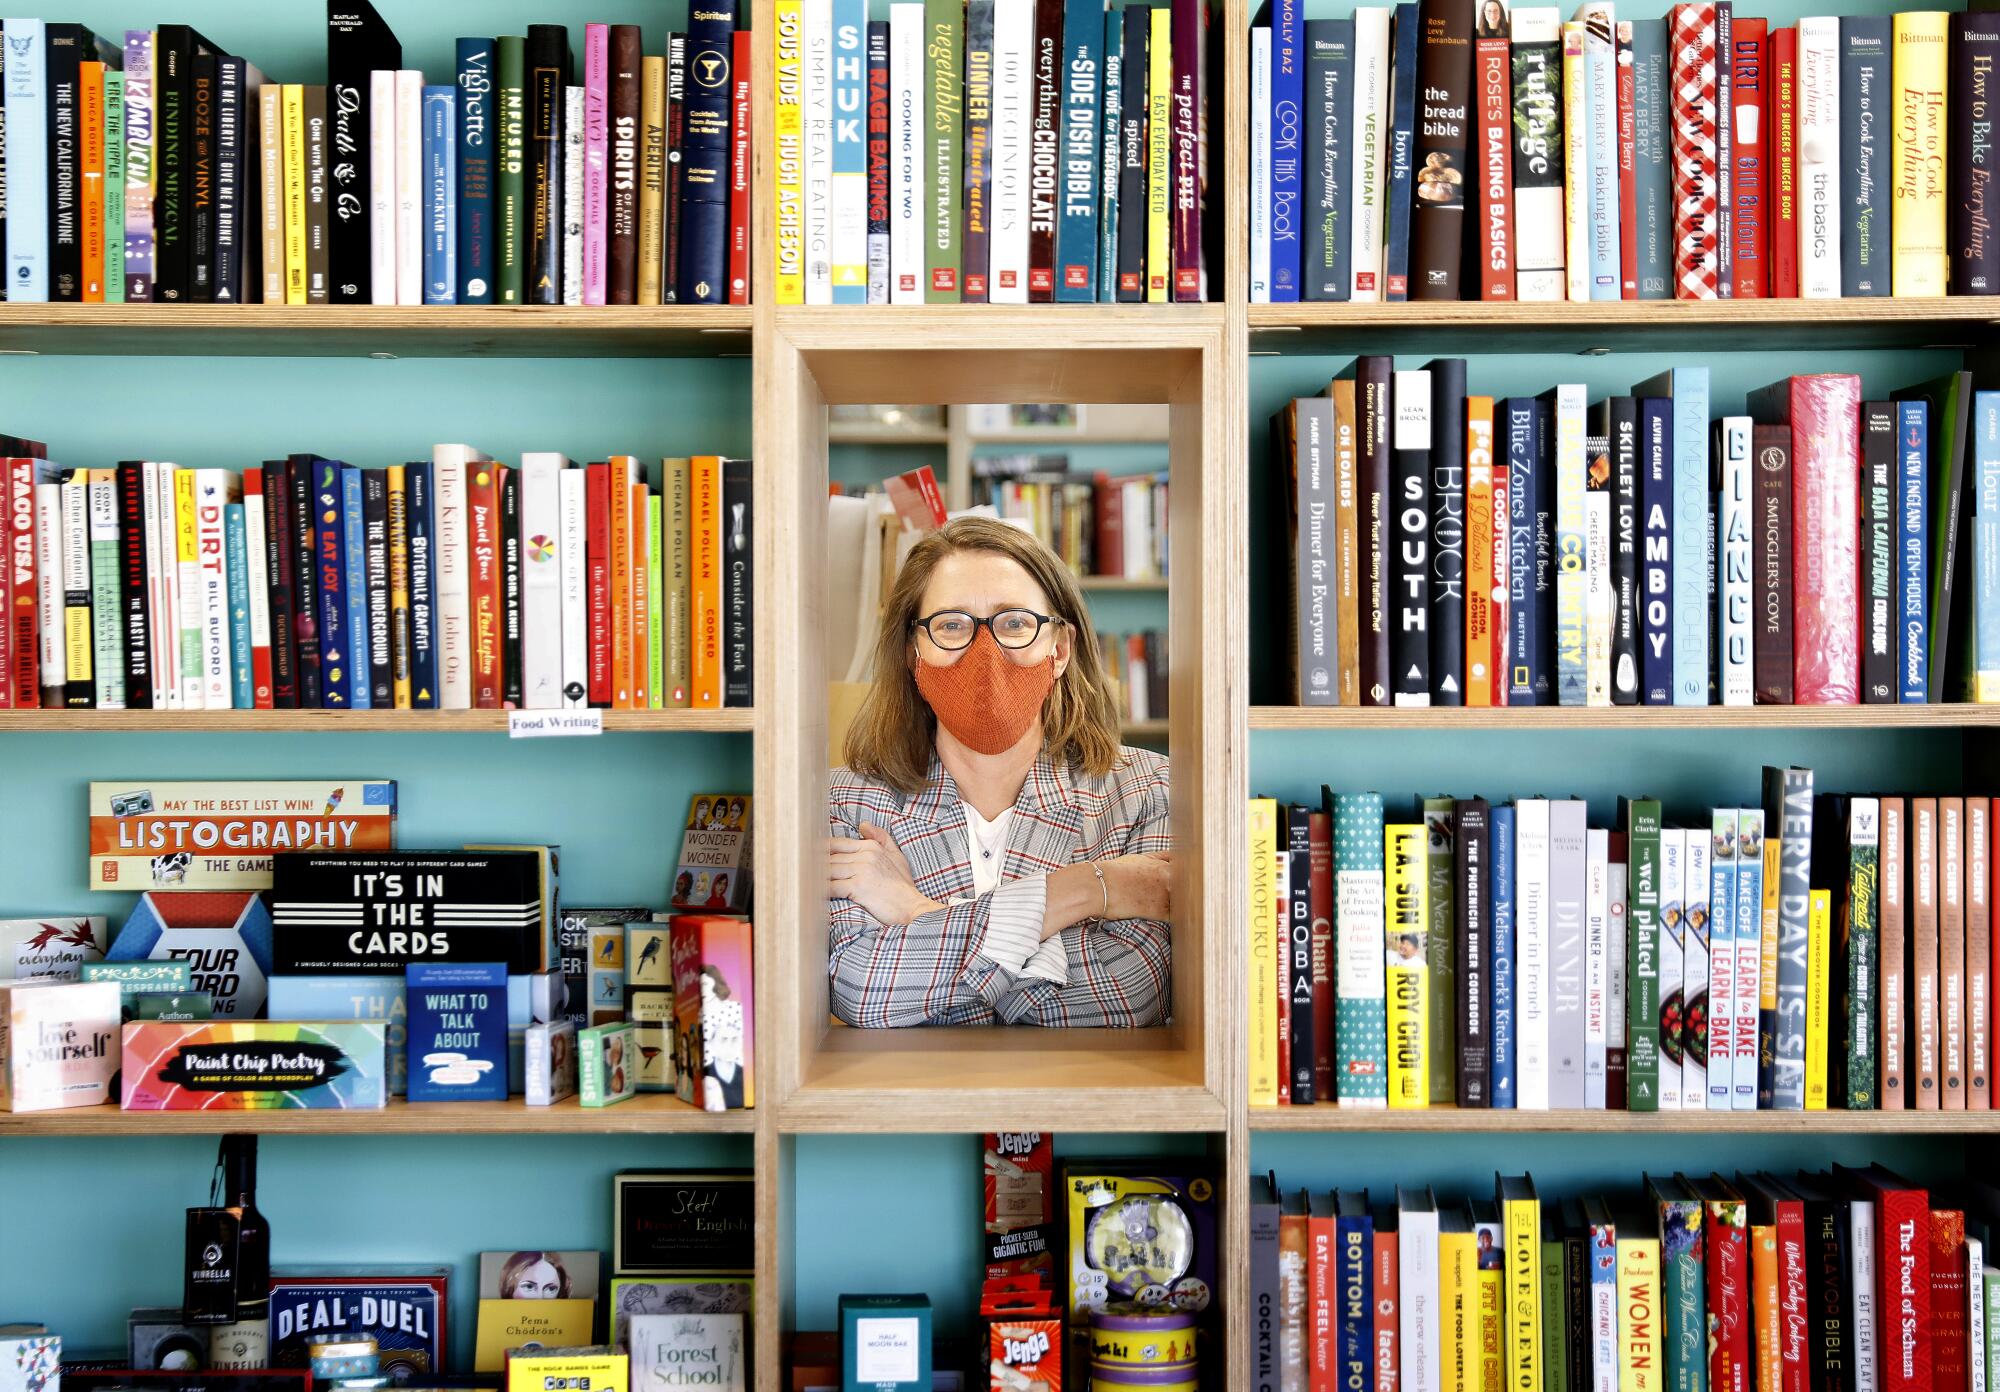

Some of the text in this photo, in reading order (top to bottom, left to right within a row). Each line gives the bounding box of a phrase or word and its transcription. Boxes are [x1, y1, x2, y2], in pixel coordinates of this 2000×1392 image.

[694, 11, 731, 21] Spirited
[1428, 28, 1444, 36] Levy
[1964, 32, 1998, 41] Bittman
[1851, 37, 1881, 45] Bittman
[670, 38, 684, 99] WINE FOLLY
[837, 25, 859, 142] SHUK
[929, 24, 960, 132] vegetables
[459, 52, 490, 146] Vignette
[1424, 106, 1464, 119] bread
[1425, 88, 1448, 101] the
[127, 80, 148, 189] KOMBUCHA
[337, 84, 361, 155] Death
[507, 88, 521, 173] INFUSED
[1067, 45, 1094, 217] THE SIDE DISH BIBLE
[1424, 123, 1459, 136] bible
[57, 83, 72, 244] THE NEW CALIFORNIA WINE
[902, 90, 911, 219] COOKING FOR TWO
[1124, 119, 1142, 168] spiced
[1395, 131, 1410, 179] bowls
[1487, 57, 1506, 271] ROSE'S BAKING BASICS
[338, 193, 361, 222] Co
[938, 139, 950, 249] ILLUSTRATED
[1814, 172, 1830, 258] the basics
[1906, 452, 1920, 477] NEW
[1619, 421, 1632, 552] SKILLET LOVE
[1906, 480, 1921, 533] ENGLAND
[13, 464, 32, 585] TACO USA
[201, 507, 222, 574] DIRT
[1435, 467, 1462, 602] BROCK
[1728, 427, 1750, 664] BIANCO
[1401, 477, 1427, 631] SOUTH
[369, 521, 388, 664] THE TRUFFLE UNDERGROUND
[1646, 505, 1667, 658] AMBOY
[208, 581, 220, 675] BILL BUFORD
[733, 561, 744, 672] Consider the Fork
[1478, 597, 1486, 634] ACTION
[1622, 610, 1630, 638] BYRN
[1767, 588, 1779, 633] COVE
[1907, 621, 1922, 684] Cookbook
[512, 717, 598, 730] Food Writing
[164, 800, 312, 810] MAY THE BEST LIST WIN!
[119, 821, 358, 848] LISTOGRAPHY
[688, 833, 736, 847] WONDER
[1635, 824, 1657, 833] Clarke
[1888, 809, 1897, 860] AYESHA
[205, 860, 273, 871] THE GAME
[686, 852, 729, 864] WOMEN
[354, 872, 443, 897] IT'S IN
[1254, 839, 1269, 958] MOMOFUKU
[1888, 863, 1898, 905] CURRY
[373, 904, 423, 925] THE
[1633, 863, 1656, 976] well plated
[348, 932, 449, 954] CARDS
[1312, 918, 1331, 983] Chaat
[1712, 948, 1731, 1000] LEARN
[1888, 974, 1897, 993] THE
[158, 1011, 193, 1021] Authors
[426, 994, 487, 1010] WHAT TO
[440, 1014, 474, 1028] TALK
[1888, 996, 1897, 1029] FULL
[434, 1033, 480, 1048] ABOUT
[1711, 1018, 1729, 1058] BAKE
[1888, 1032, 1897, 1072] PLATE
[186, 1054, 325, 1074] Paint Chip Poetry
[582, 1039, 596, 1101] GENIUS
[996, 1132, 1041, 1154] Jenga
[1822, 1214, 1833, 1239] THE
[993, 1238, 1046, 1258] GIGANTIC FUN!
[1316, 1235, 1328, 1262] EAT
[1347, 1232, 1362, 1318] BOTTOM
[278, 1298, 347, 1340] DEAL
[362, 1297, 429, 1339] DUEL
[521, 1315, 548, 1325] Pema
[1318, 1300, 1328, 1335] FEEL
[1900, 1220, 1916, 1378] The Food of Sichuan
[1003, 1330, 1049, 1364] Jenga
[1629, 1284, 1650, 1368] WOMEN
[1826, 1320, 1840, 1370] BIBLE
[658, 1344, 717, 1364] Forest
[654, 1365, 722, 1386] School
